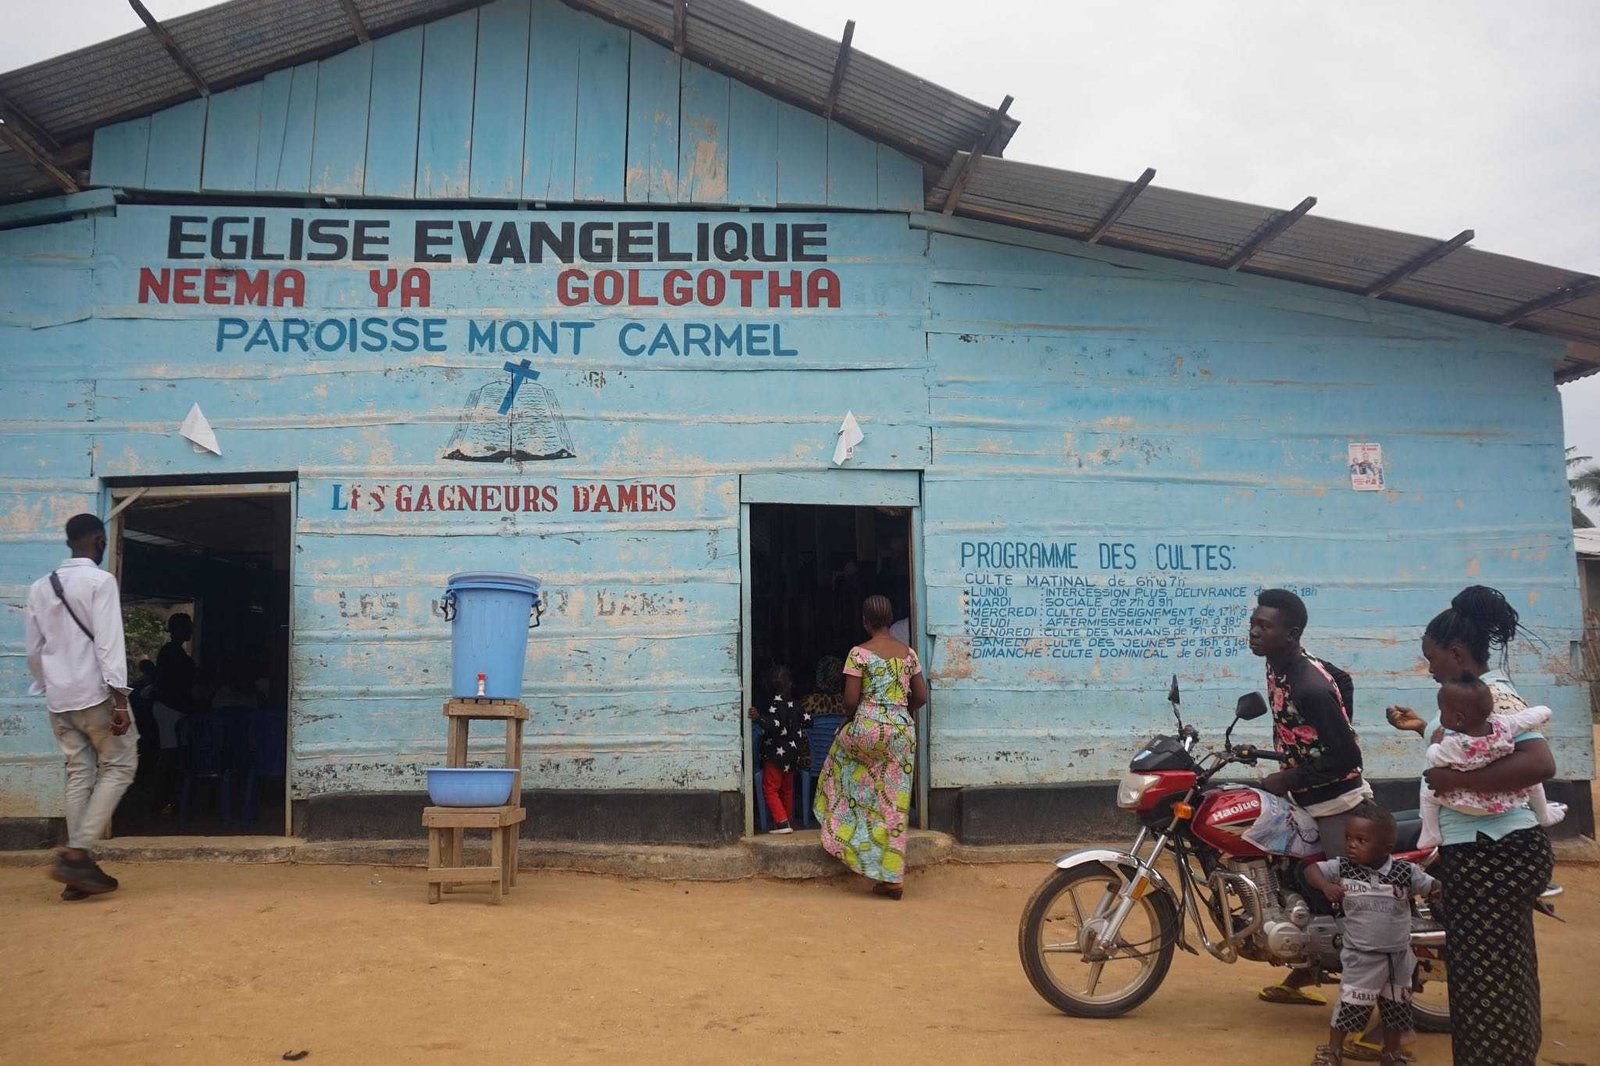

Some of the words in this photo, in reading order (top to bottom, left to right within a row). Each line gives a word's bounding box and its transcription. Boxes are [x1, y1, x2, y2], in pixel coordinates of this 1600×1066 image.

[167, 215, 390, 263] EGLISE
[414, 219, 828, 264] EVANGELIQUE
[139, 268, 305, 307] NEEMA
[369, 268, 431, 308] YA
[557, 268, 841, 309] GOLGOTHA
[215, 318, 447, 353] PAROISSE
[468, 321, 596, 355] MONT
[618, 322, 799, 357] CARMEL
[395, 484, 559, 513] GAGNEURS
[572, 484, 677, 513] D'AMES
[961, 542, 1078, 569] PROGRAMME
[1099, 543, 1137, 570] DES
[965, 573, 1013, 586] CULTE
[1026, 575, 1096, 588] MATINAL
[1107, 573, 1126, 587] de
[970, 587, 1008, 597] LUNDI
[1045, 587, 1130, 598] INTERCESSION
[1135, 587, 1168, 598] PLUS
[1175, 587, 1247, 598] DELIVRANCE
[970, 597, 1012, 608] MARDI
[1045, 598, 1103, 608] SOCIALE
[970, 606, 1037, 618] MERCREDI
[1046, 607, 1083, 617] CULTE
[970, 617, 1011, 628] JEUDI
[1045, 617, 1160, 627] AFFERMISSEMENT
[971, 627, 1034, 637] VENDREDI
[1043, 627, 1080, 637] CULTE
[1086, 627, 1110, 637] DES
[1113, 626, 1171, 637] MAMANS
[1088, 637, 1115, 647] DES
[1122, 637, 1176, 648] JEUNES
[971, 647, 1043, 659] DIMANCHE
[1052, 648, 1093, 658] CULTE
[1099, 648, 1169, 659] DOMINICAL
